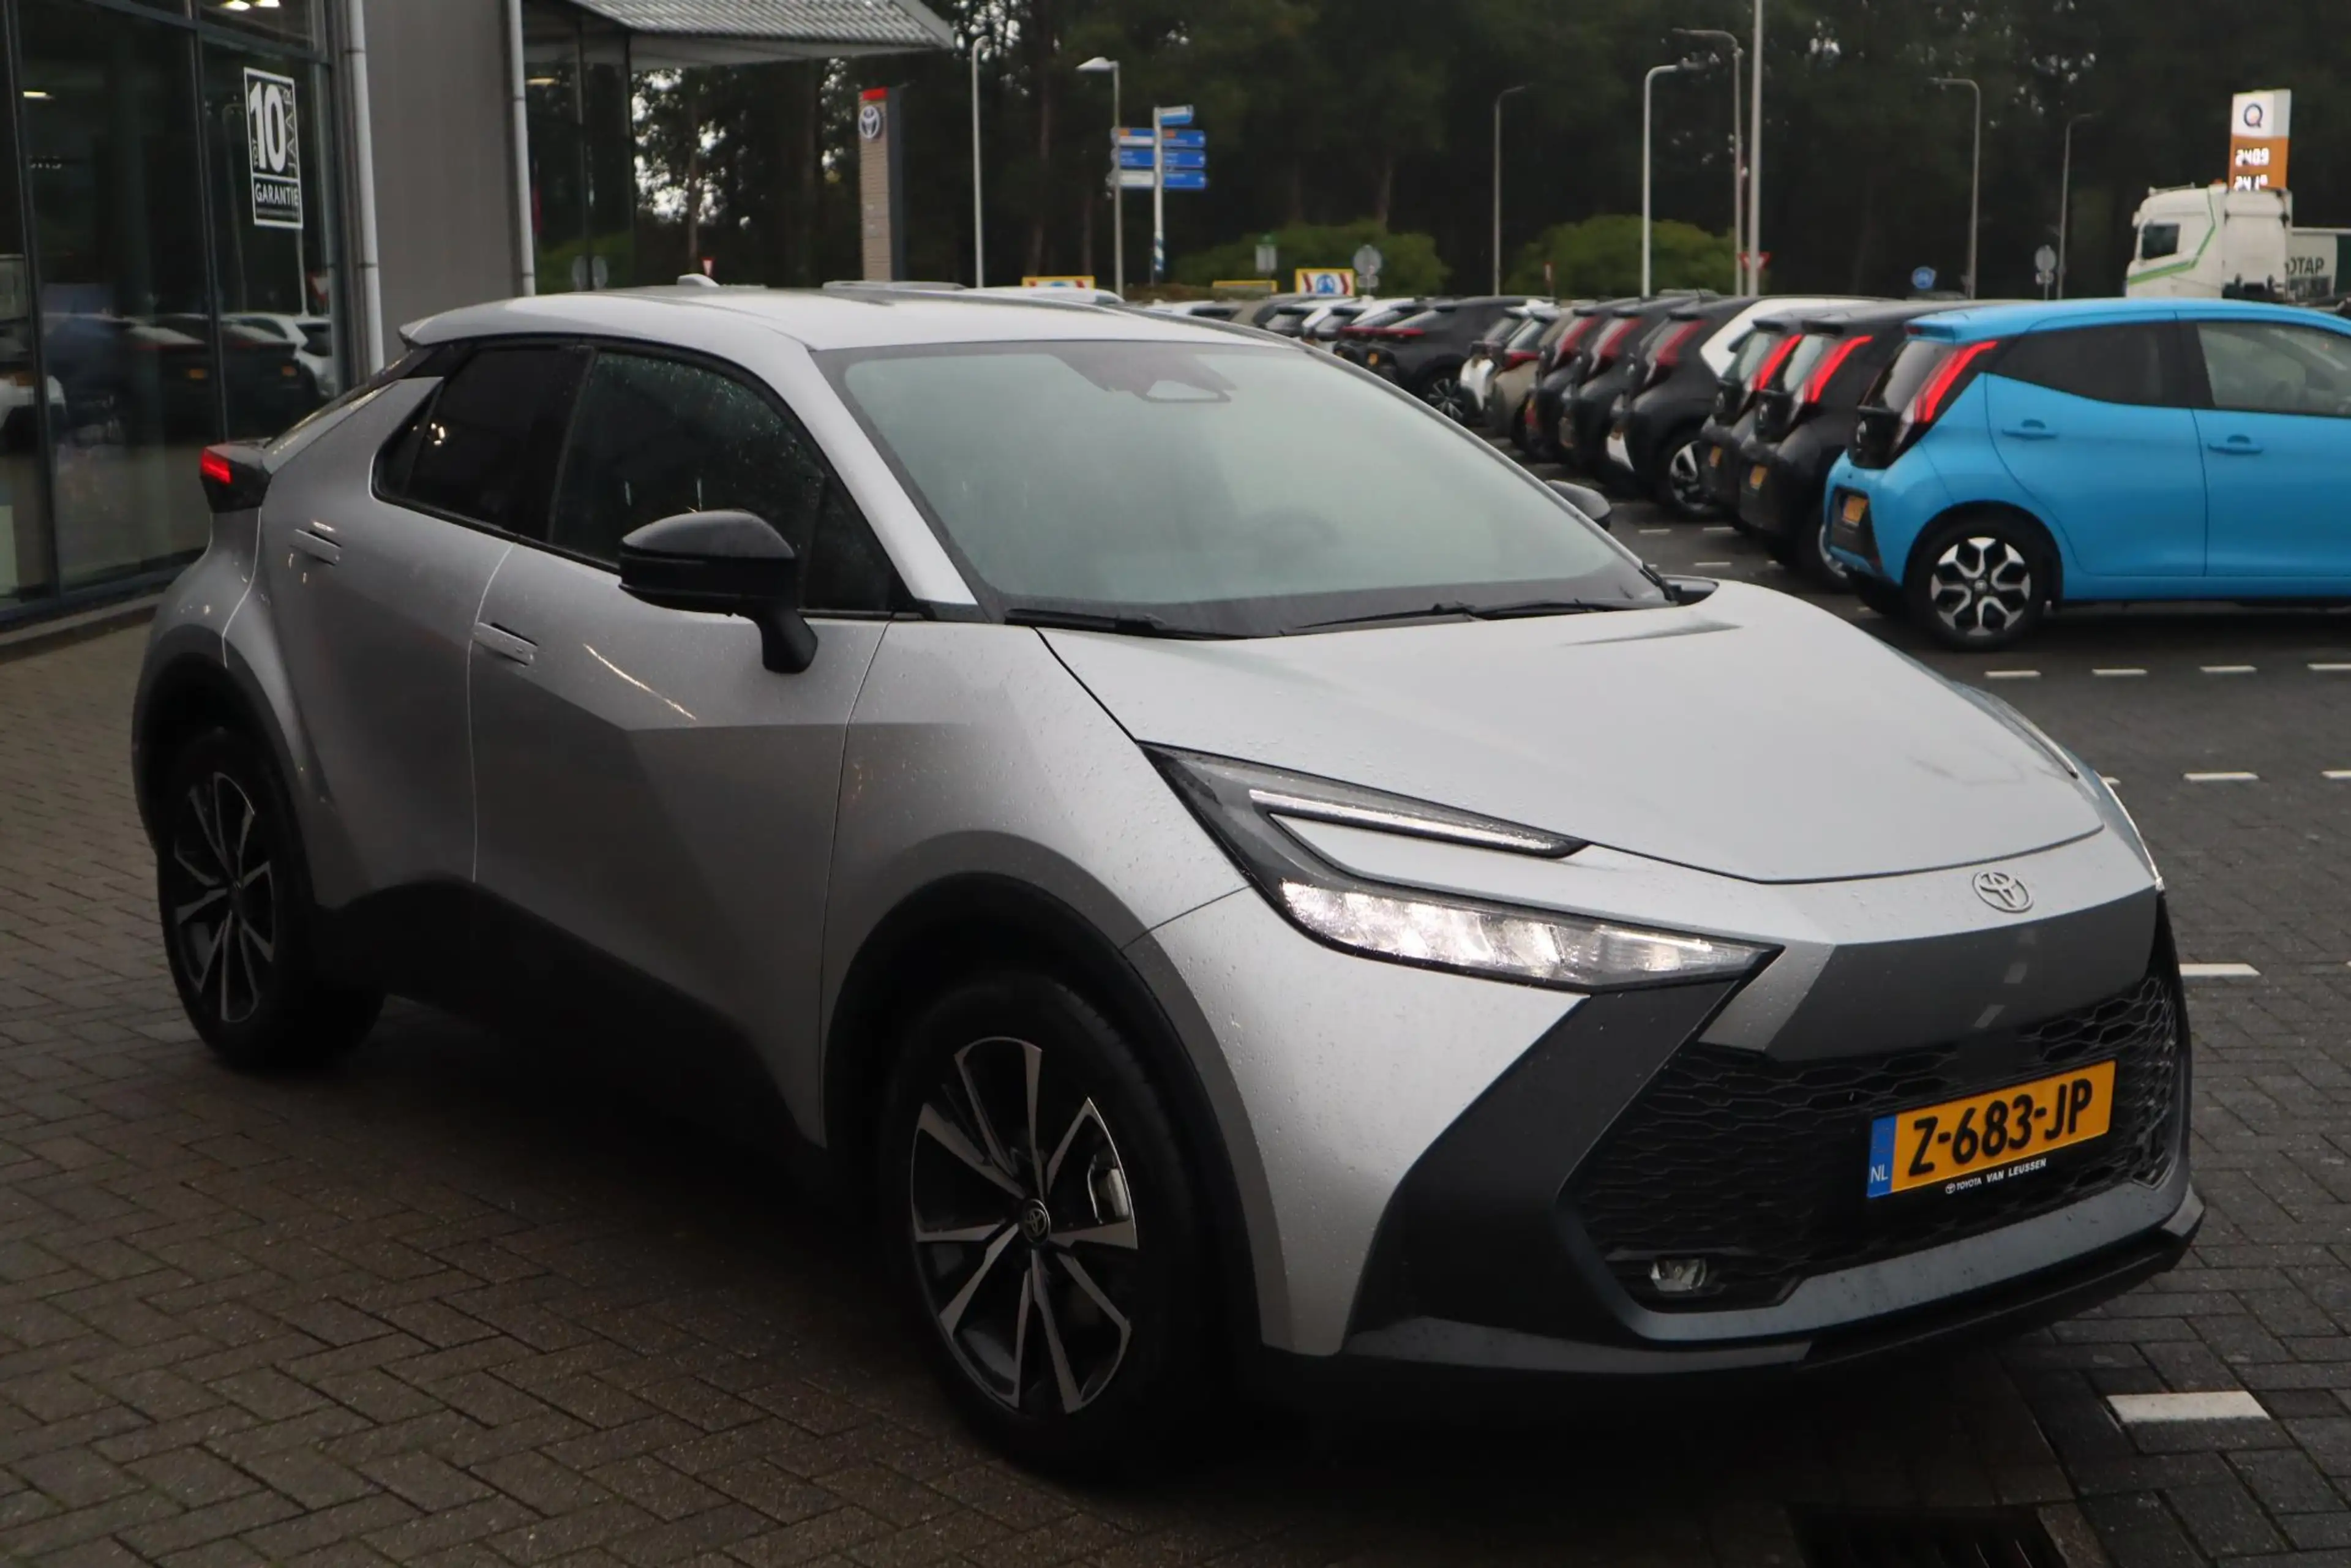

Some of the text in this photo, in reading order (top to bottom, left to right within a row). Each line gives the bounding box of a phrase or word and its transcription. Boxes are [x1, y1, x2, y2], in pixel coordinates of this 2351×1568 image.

[249, 80, 286, 173] 10
[2243, 103, 2263, 128] Q
[255, 182, 299, 206] GARANTIE
[1908, 1078, 2093, 1177] Z-683-JP
[1870, 1166, 1888, 1184] NL
[1956, 1158, 2047, 1190] TOYOTA VAN LEUSSEN
